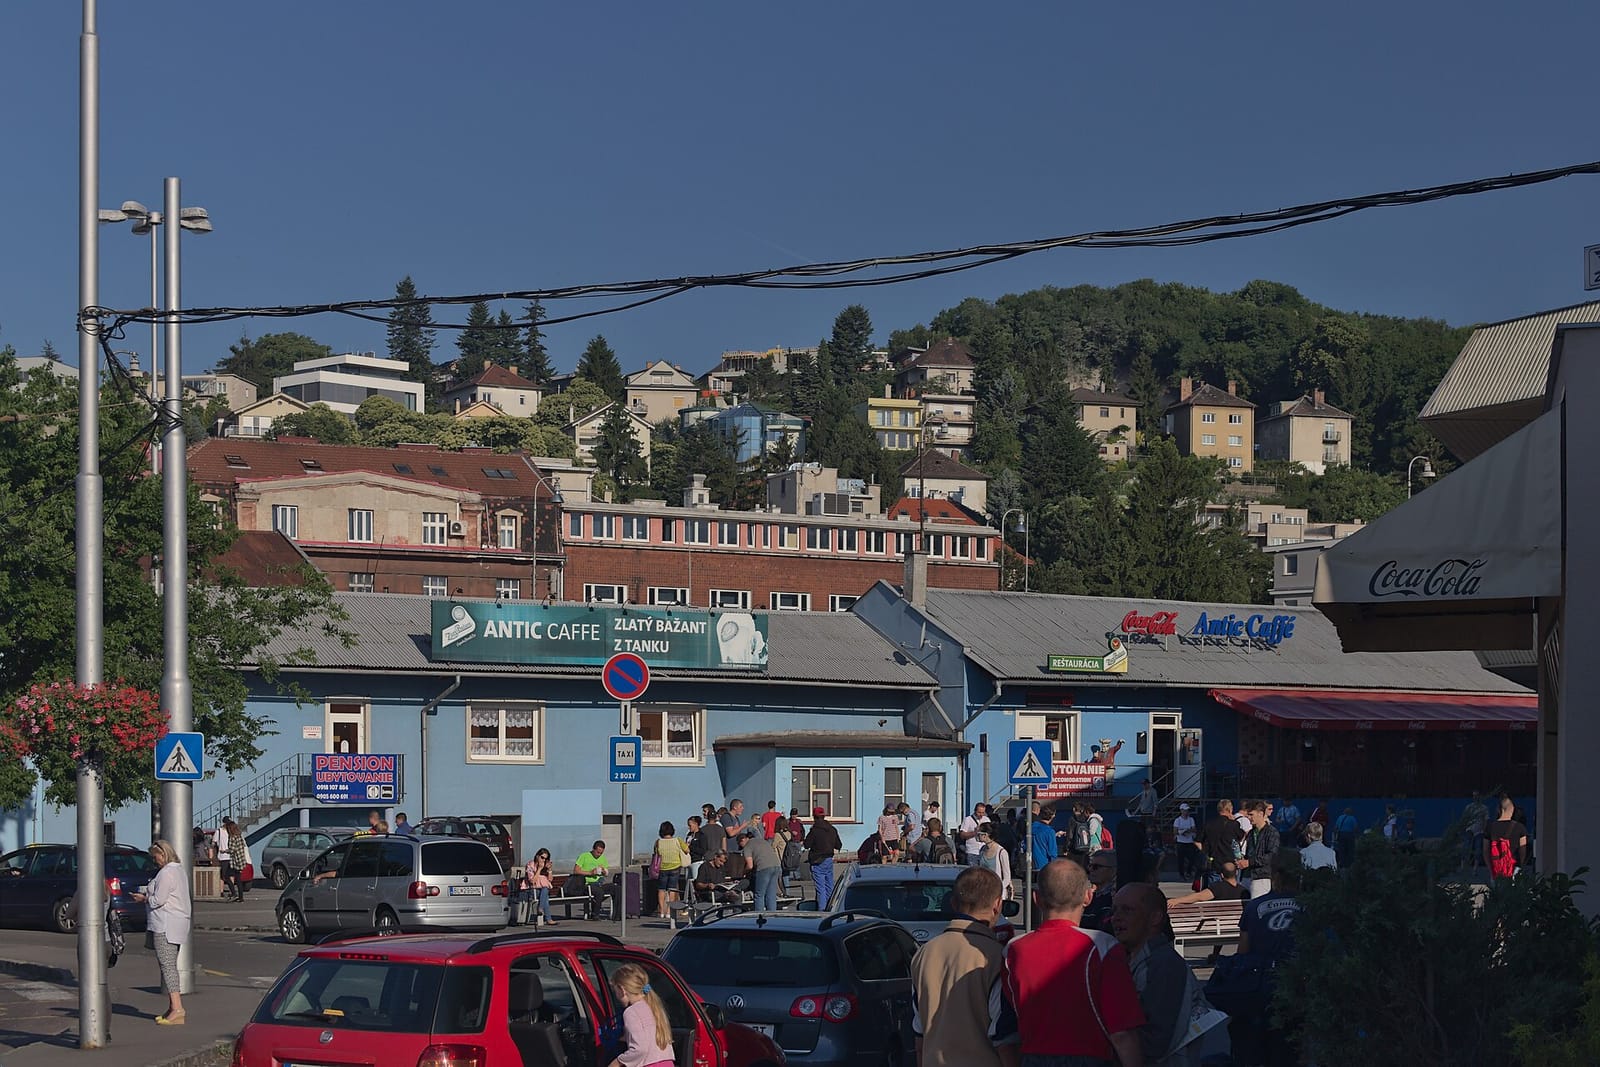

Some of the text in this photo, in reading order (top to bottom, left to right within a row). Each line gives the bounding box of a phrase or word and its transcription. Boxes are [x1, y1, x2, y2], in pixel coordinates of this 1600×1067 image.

[1369, 558, 1488, 597] Coca-Cola
[483, 619, 542, 640] ANTIC
[546, 622, 600, 642] CAFFE
[614, 615, 707, 635] ZLATÝ BAŽANT
[1192, 611, 1297, 645] Antic Caffé
[614, 639, 670, 654] Z TANKU
[1052, 656, 1100, 670] REŠTAURÁCIA
[617, 750, 634, 758] TAXI
[315, 755, 394, 772] PENSION
[1052, 764, 1105, 775] YTOVANIE
[315, 771, 394, 783] UBYTOVANIE
